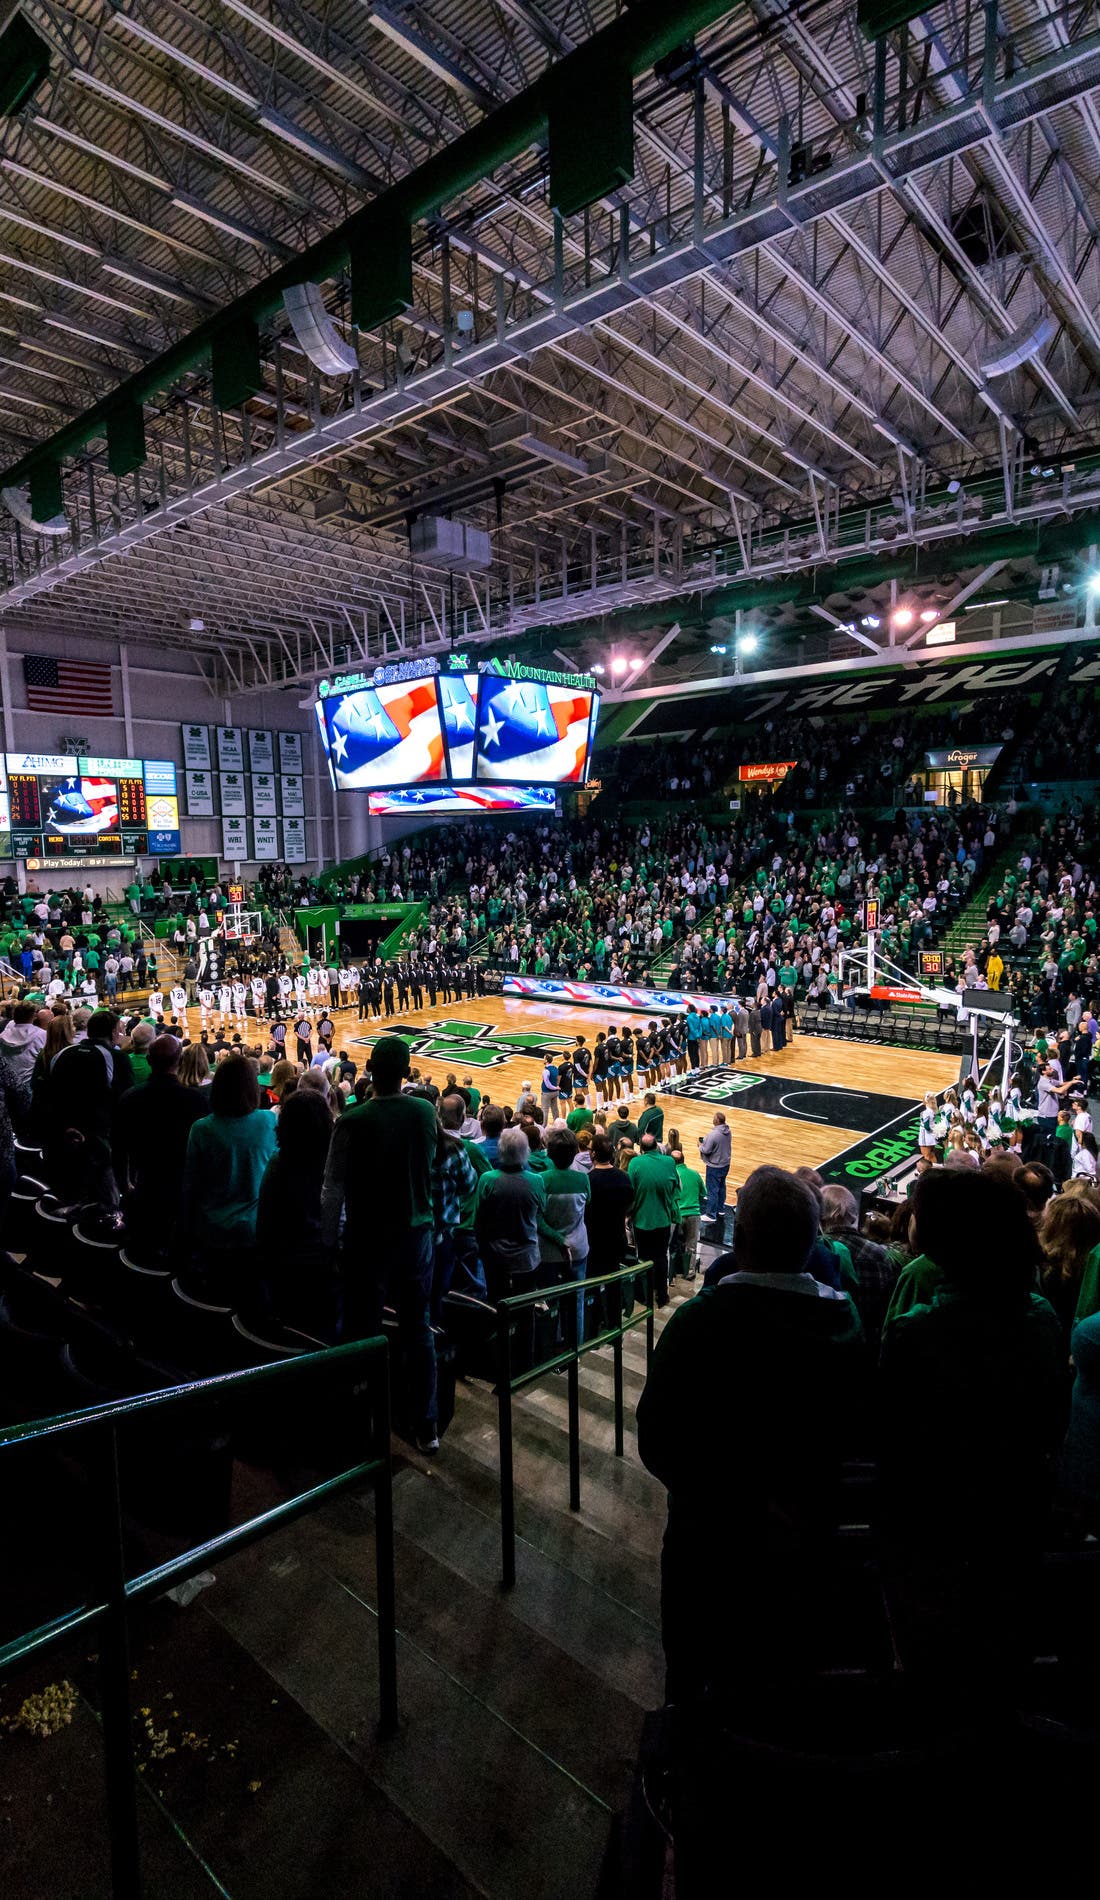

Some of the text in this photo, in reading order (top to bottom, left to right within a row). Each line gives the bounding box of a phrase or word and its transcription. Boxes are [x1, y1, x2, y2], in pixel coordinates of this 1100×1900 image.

[947, 750, 978, 765] Kroger
[34, 847, 40, 856] 0
[44, 859, 83, 868] Play Today!
[231, 892, 241, 901] 30
[868, 911, 875, 928] 30
[925, 962, 938, 972] 30
[807, 1030, 883, 1045] Marshall
[844, 1138, 916, 1178] HERD
